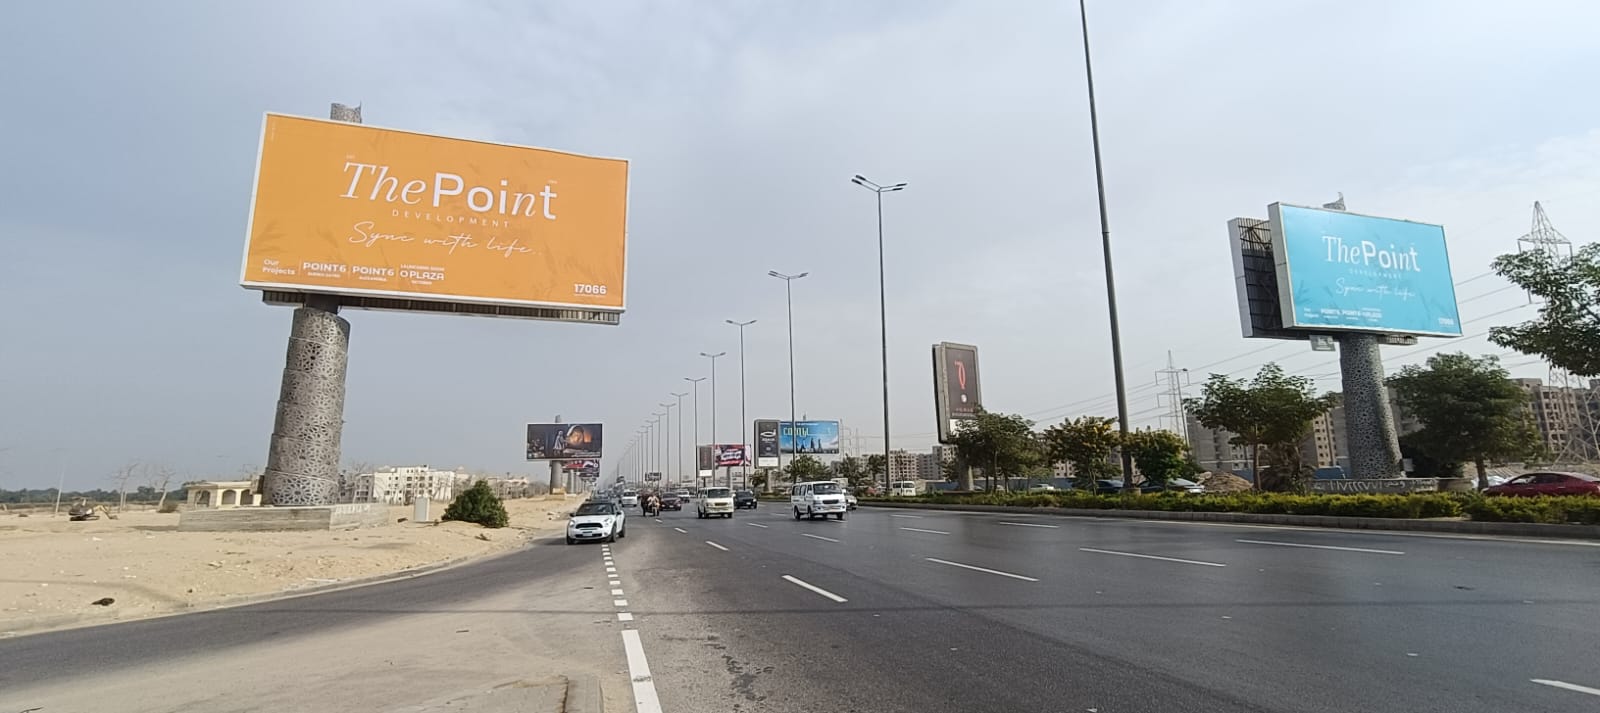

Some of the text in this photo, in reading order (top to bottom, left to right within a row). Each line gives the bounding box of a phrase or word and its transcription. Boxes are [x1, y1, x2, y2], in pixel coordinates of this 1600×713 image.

[392, 208, 510, 229] DEVELOPMENT
[349, 220, 416, 248] Sync
[423, 232, 479, 255] with
[263, 258, 280, 266] Our
[303, 261, 347, 273] POINT6
[262, 266, 296, 276] Projects
[352, 265, 395, 276] POINT6
[574, 283, 607, 295] 17066
